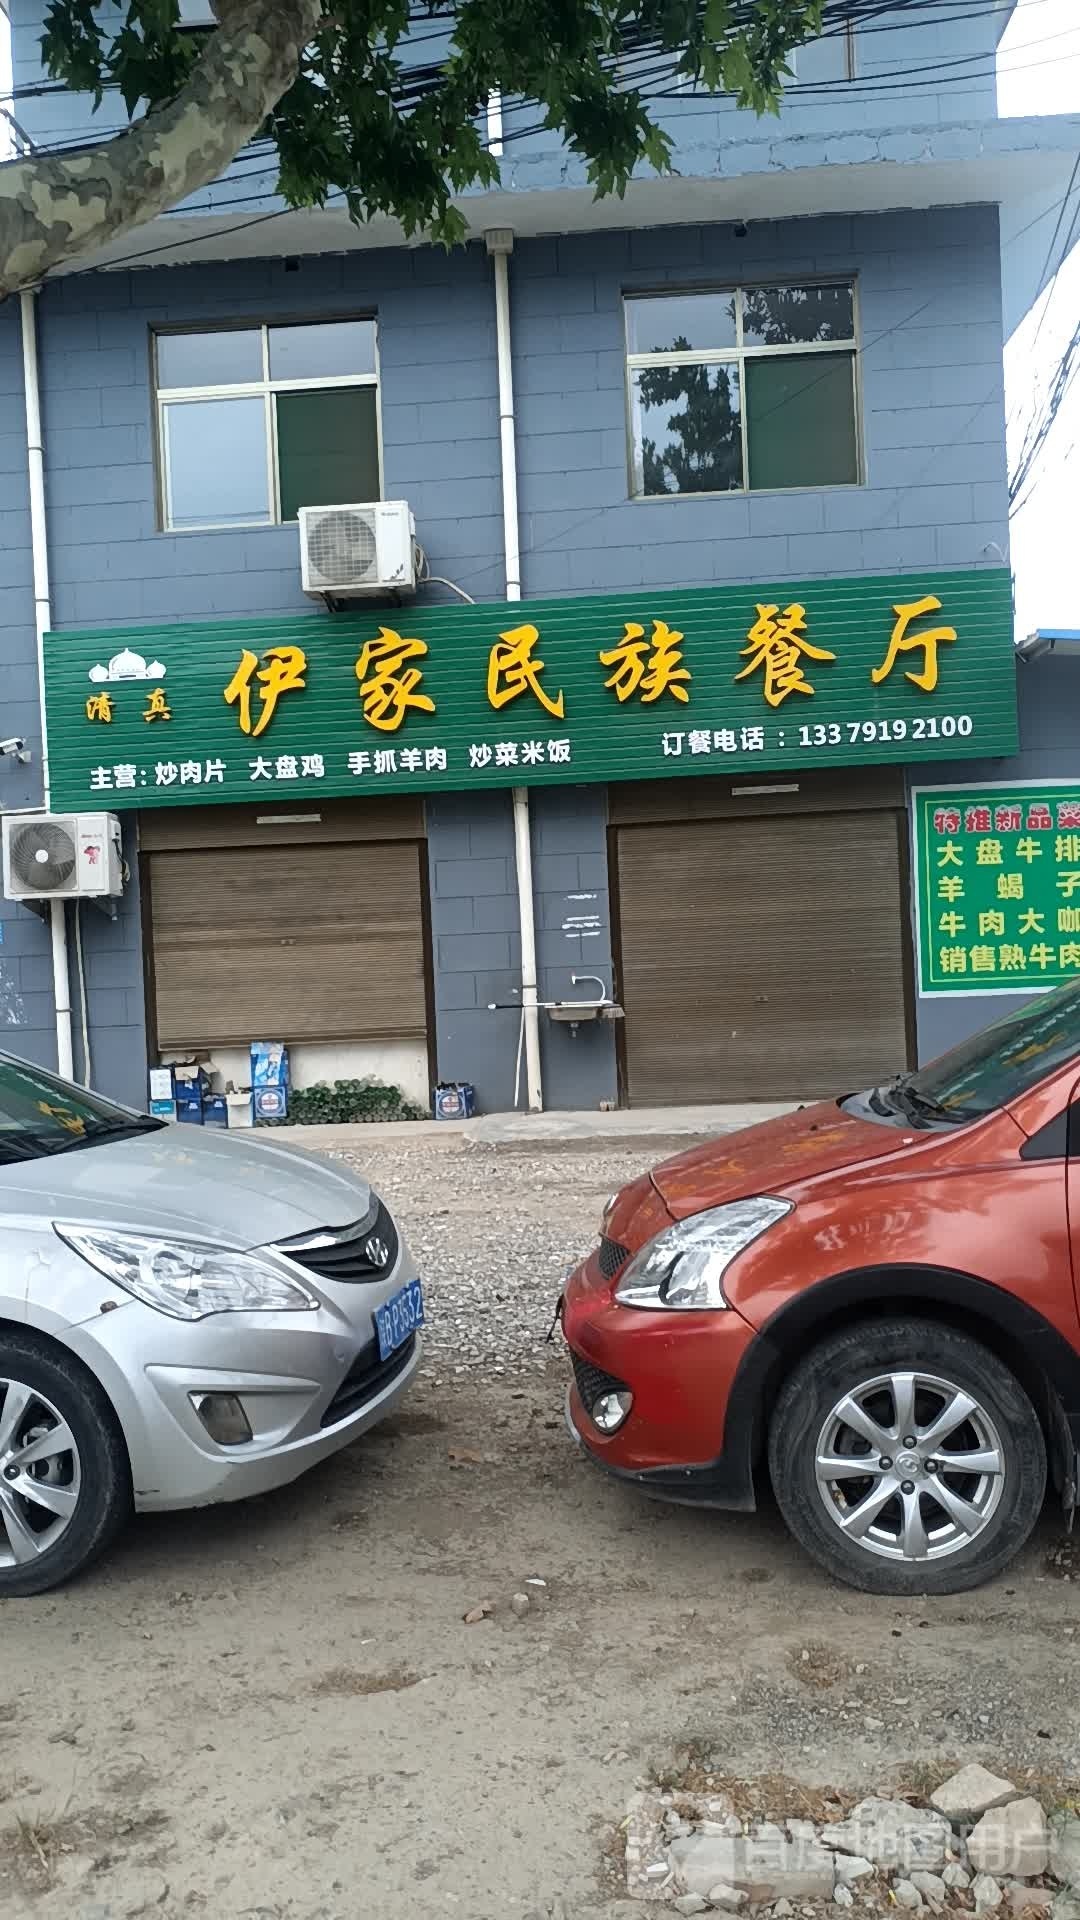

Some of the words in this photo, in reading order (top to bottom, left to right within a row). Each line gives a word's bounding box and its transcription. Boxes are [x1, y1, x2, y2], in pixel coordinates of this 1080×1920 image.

[224, 596, 957, 737] 伊家民族餐厅
[86, 688, 172, 722] 清真
[249, 753, 325, 781] 大盘鸡
[347, 746, 447, 776] 手抓羊肉
[469, 738, 571, 768] 炒菜米饭
[937, 835, 1080, 867] 大盘牛排
[939, 906, 1080, 938] 牛肉大咖
[940, 942, 1080, 973] 销售熟牛肉
